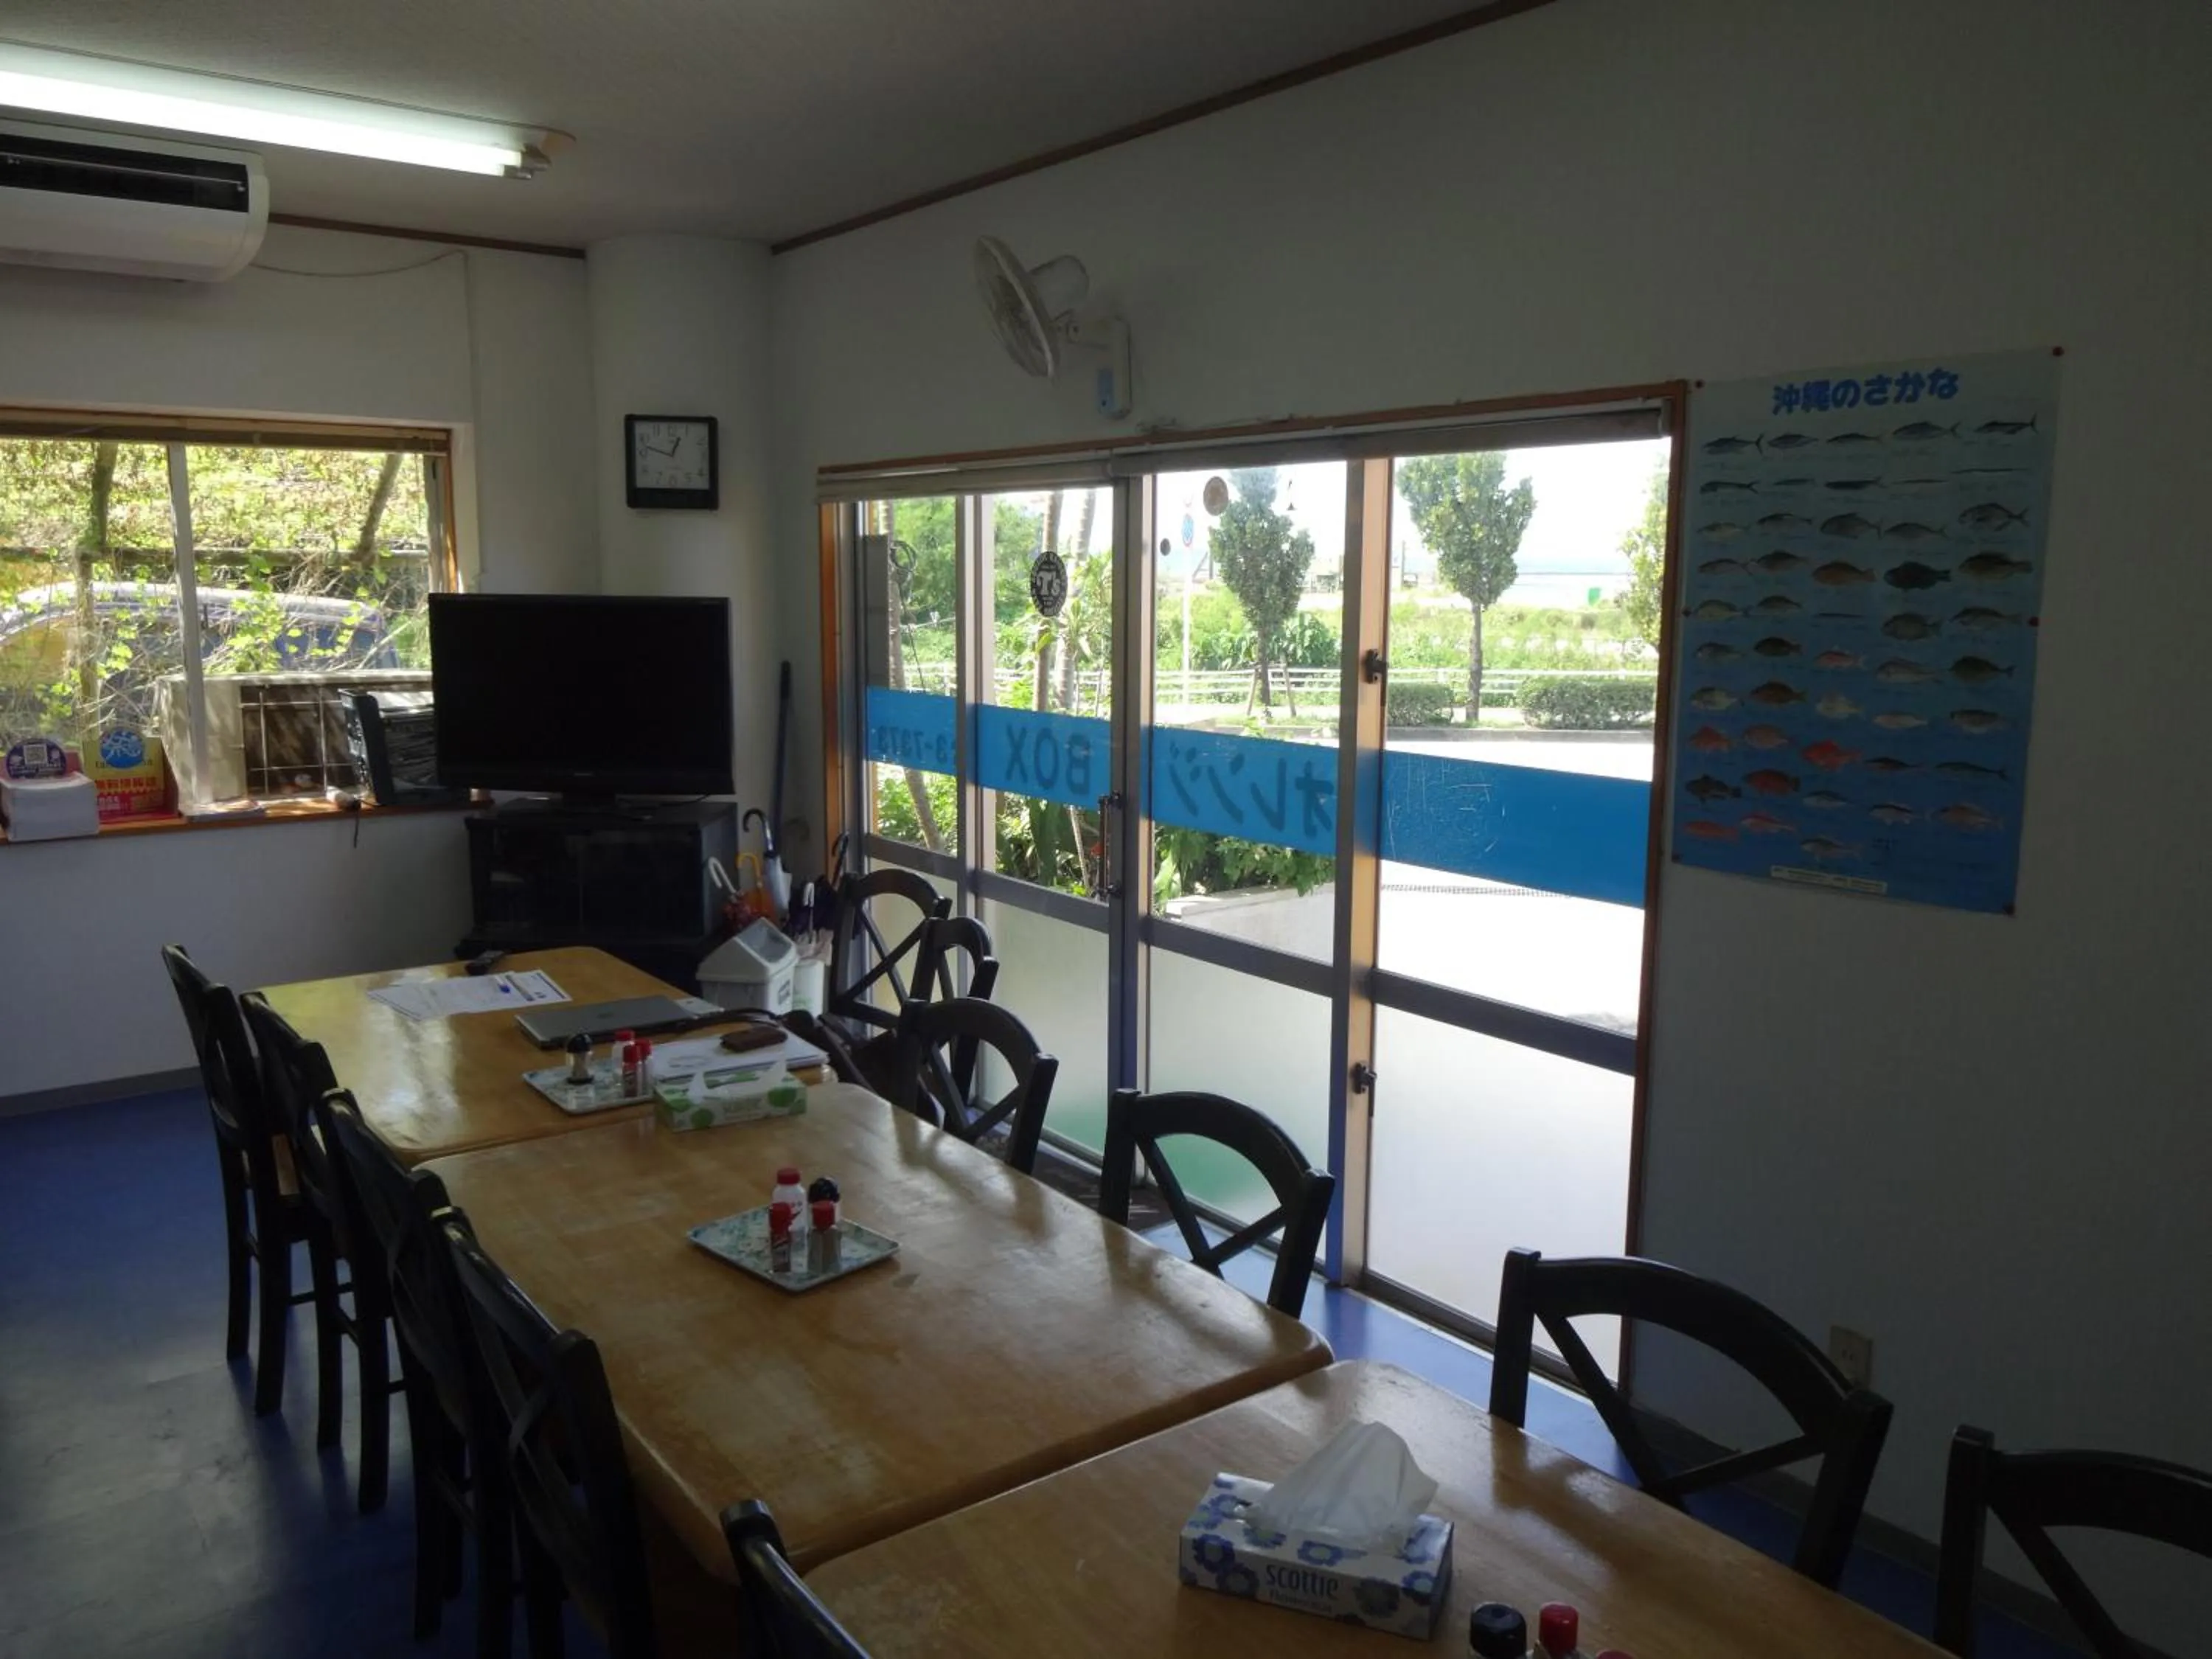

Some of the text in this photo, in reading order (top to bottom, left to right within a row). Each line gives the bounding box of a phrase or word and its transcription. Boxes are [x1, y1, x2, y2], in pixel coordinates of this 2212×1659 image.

[1773, 367, 1959, 415] 沖縄のさかな
